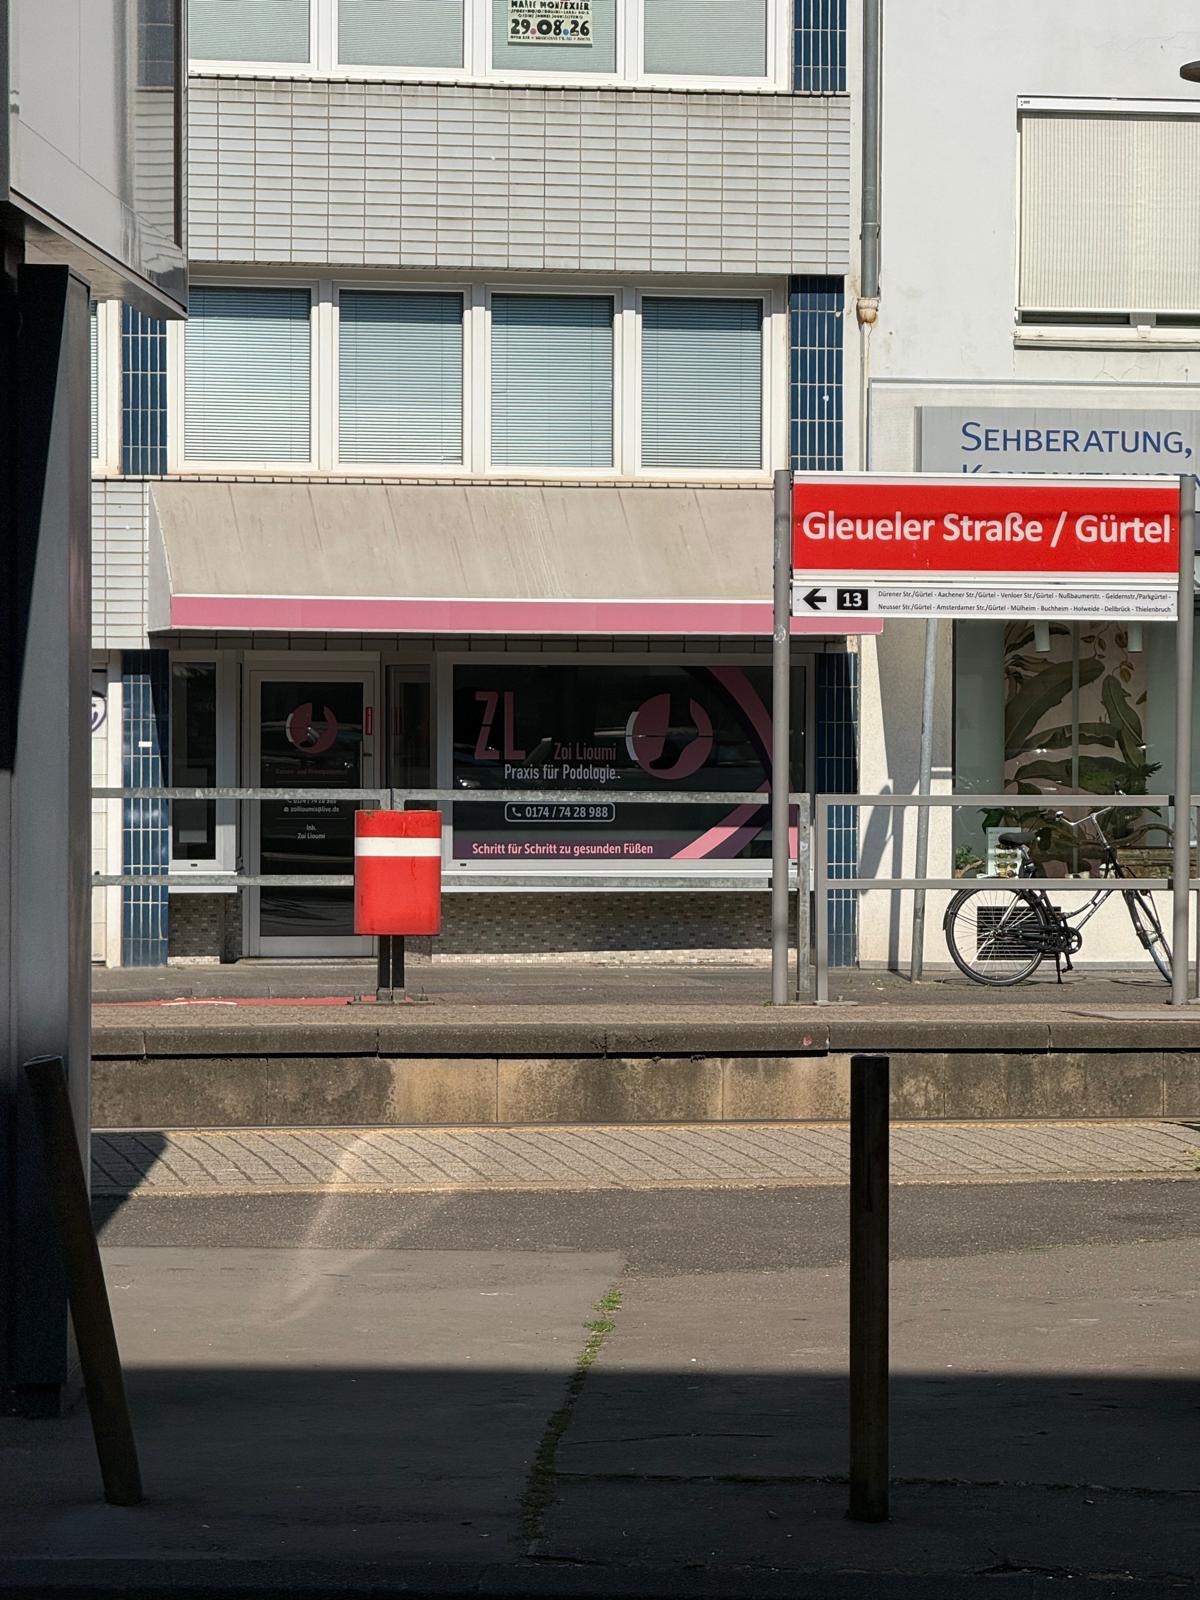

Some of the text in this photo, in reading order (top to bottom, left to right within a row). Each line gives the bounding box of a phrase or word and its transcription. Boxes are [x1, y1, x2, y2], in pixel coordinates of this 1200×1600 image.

[510, 18, 590, 37] 29.08.26
[961, 421, 1192, 459] SEHBERATUNG,
[802, 511, 1171, 548] Gleueler Straße / Gürtel
[842, 592, 863, 607] 13
[878, 590, 902, 598] Dürener
[902, 590, 933, 598] Str./Gürtel
[966, 591, 996, 599] Str./Gürtel
[1023, 592, 1054, 600] Str./Gürtel
[1058, 592, 1101, 600] Nußbaumerstr.
[1105, 593, 1168, 601] Geldernstr./Parkgürtel
[902, 603, 932, 611] Str./Gürtel
[976, 604, 1006, 612] Str./Gürtel
[1073, 605, 1100, 613] Holweide
[1104, 605, 1130, 613] Dellbrück
[474, 691, 527, 760] ZL
[554, 743, 617, 760] Zoi Lioumi
[504, 764, 616, 784] Praxis für Podologie
[525, 806, 608, 818] 0174 / 74 28 988
[472, 842, 653, 857] Schritt für Schritt zu gesunden Füßen
